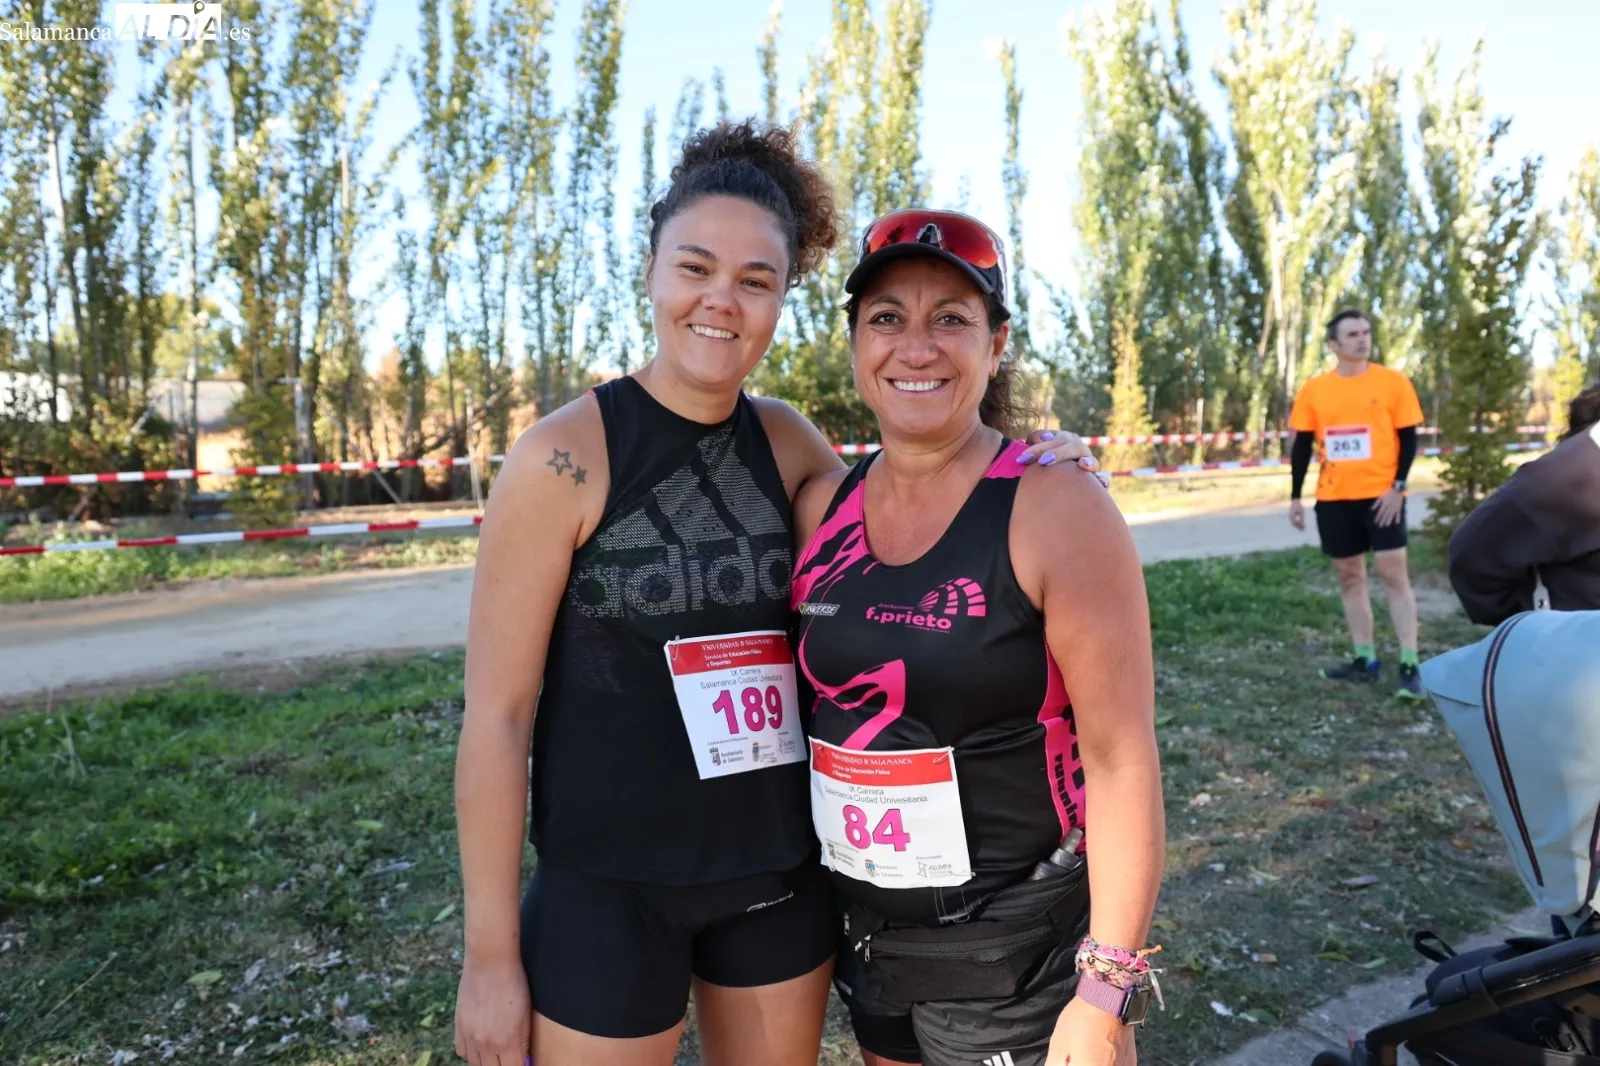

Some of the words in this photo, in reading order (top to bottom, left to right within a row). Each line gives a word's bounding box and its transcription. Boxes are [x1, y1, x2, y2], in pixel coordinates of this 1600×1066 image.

[1333, 439, 1361, 452] 263
[570, 536, 792, 618] adida
[866, 606, 952, 630] f.prieto
[700, 678, 737, 689] Salamanca
[712, 685, 783, 735] 189
[870, 757, 913, 765] SALAMANCA
[853, 794, 878, 803] Ciudad
[857, 786, 884, 795] Carrera
[1054, 753, 1079, 828] runnin
[842, 804, 911, 852] 84
